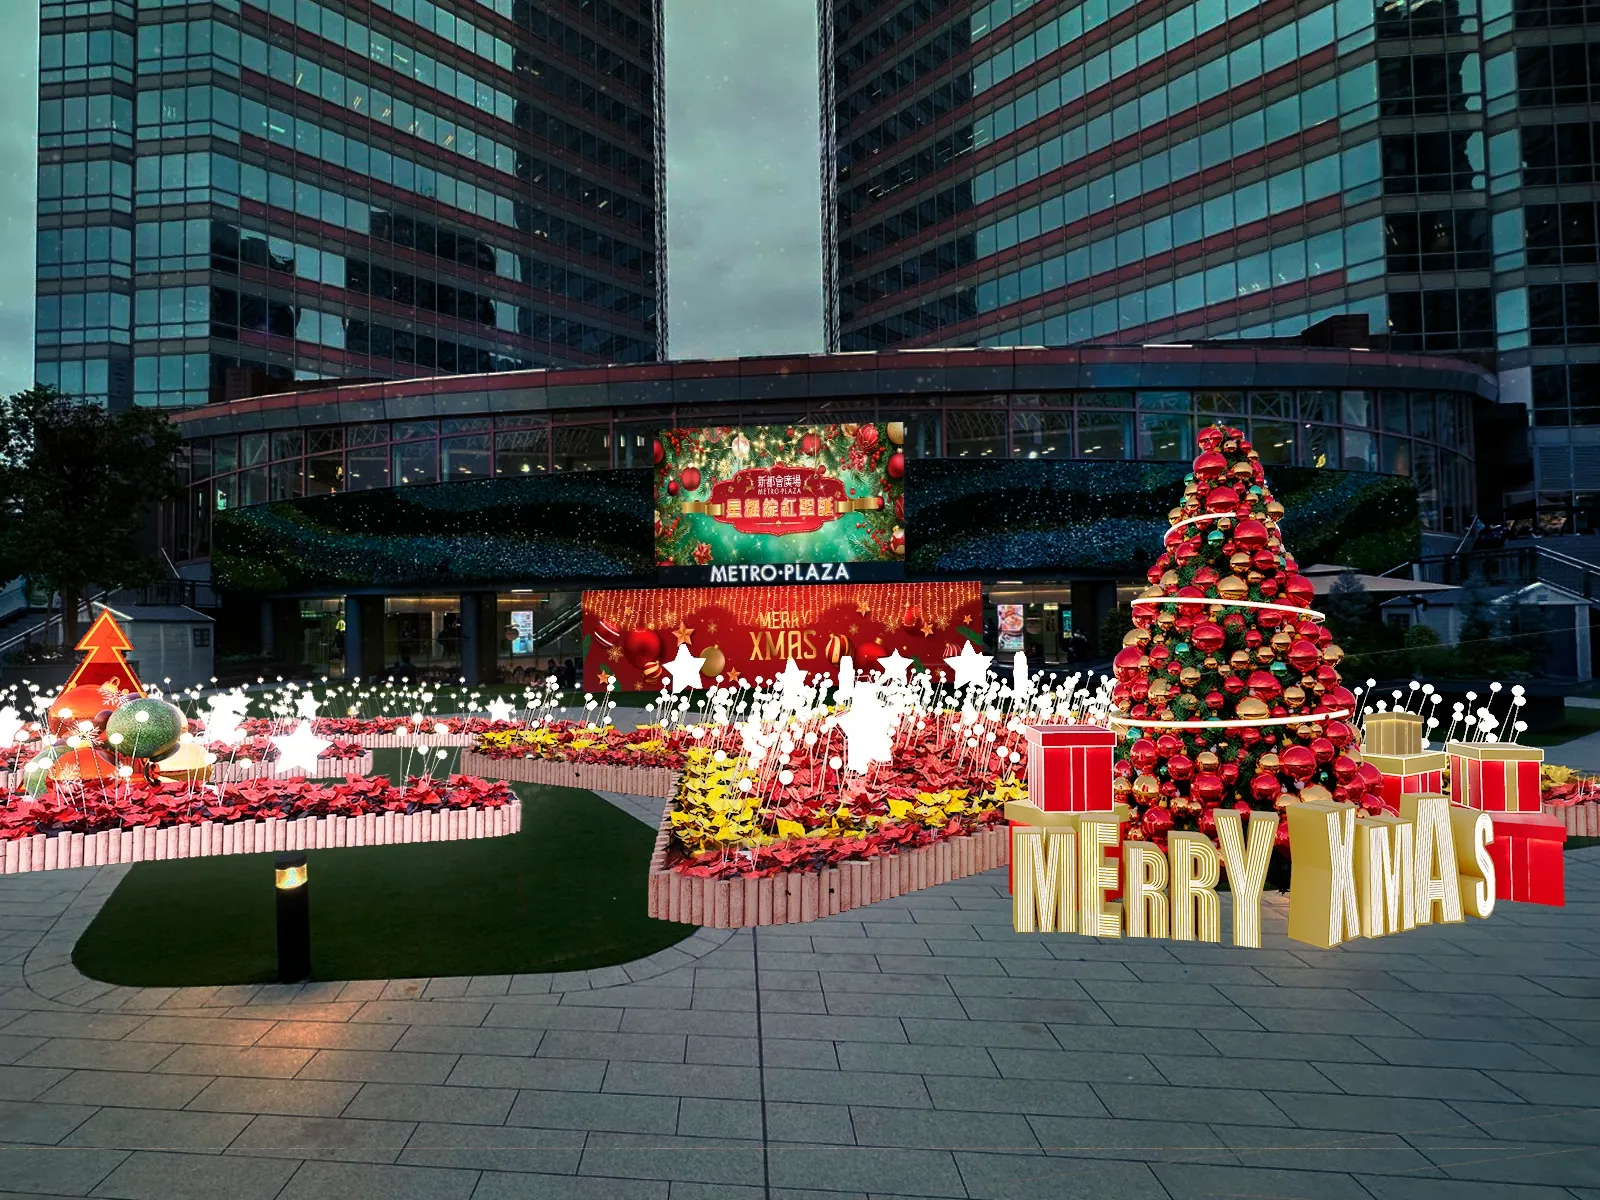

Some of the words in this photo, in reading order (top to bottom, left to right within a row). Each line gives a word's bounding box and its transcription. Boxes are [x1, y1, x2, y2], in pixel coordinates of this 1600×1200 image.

[758, 474, 802, 488] 新都會廣場
[758, 610, 811, 629] MERRY
[749, 630, 817, 661] XMAS
[1013, 808, 1277, 948] MERRY
[1290, 794, 1495, 948] XMAS
